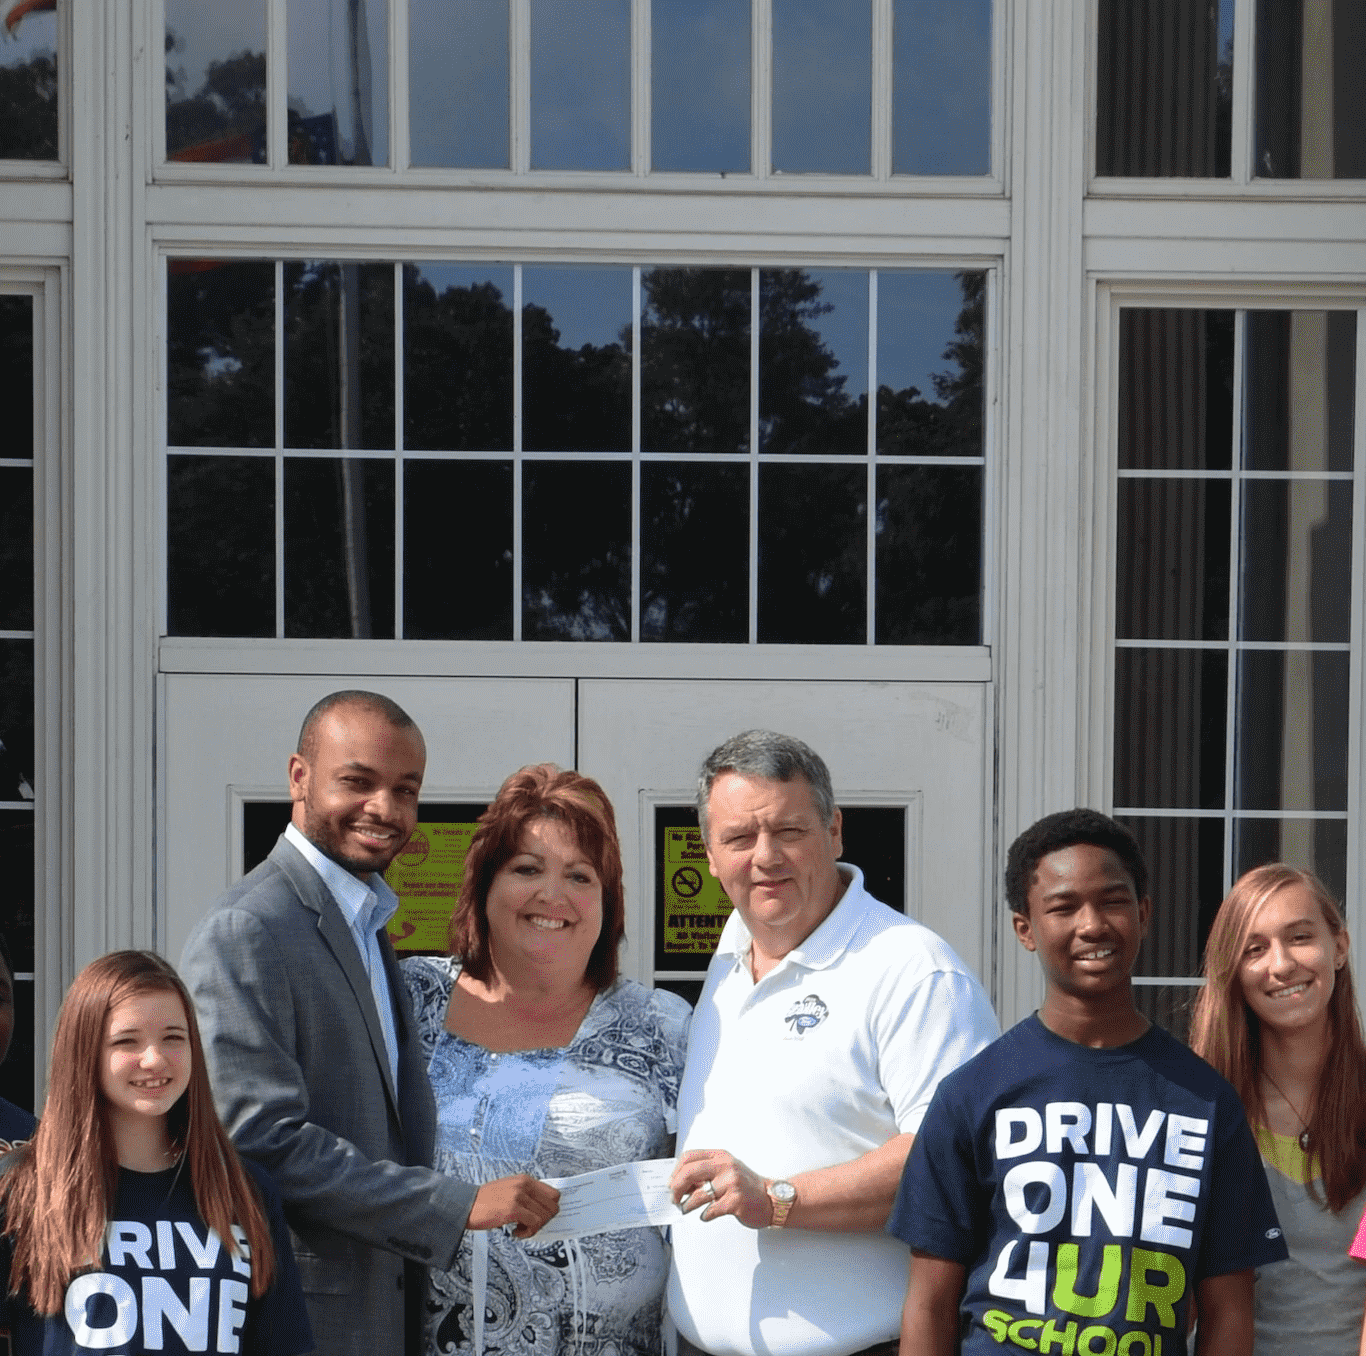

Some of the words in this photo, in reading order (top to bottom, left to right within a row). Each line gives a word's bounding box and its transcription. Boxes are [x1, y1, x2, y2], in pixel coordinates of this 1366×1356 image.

[668, 914, 731, 928] ATTENT
[995, 1101, 1209, 1171] DRIVE
[1003, 1161, 1201, 1249] ONE
[106, 1220, 252, 1279] RIVE
[988, 1240, 1187, 1329] 4UR
[64, 1272, 249, 1354] ONE
